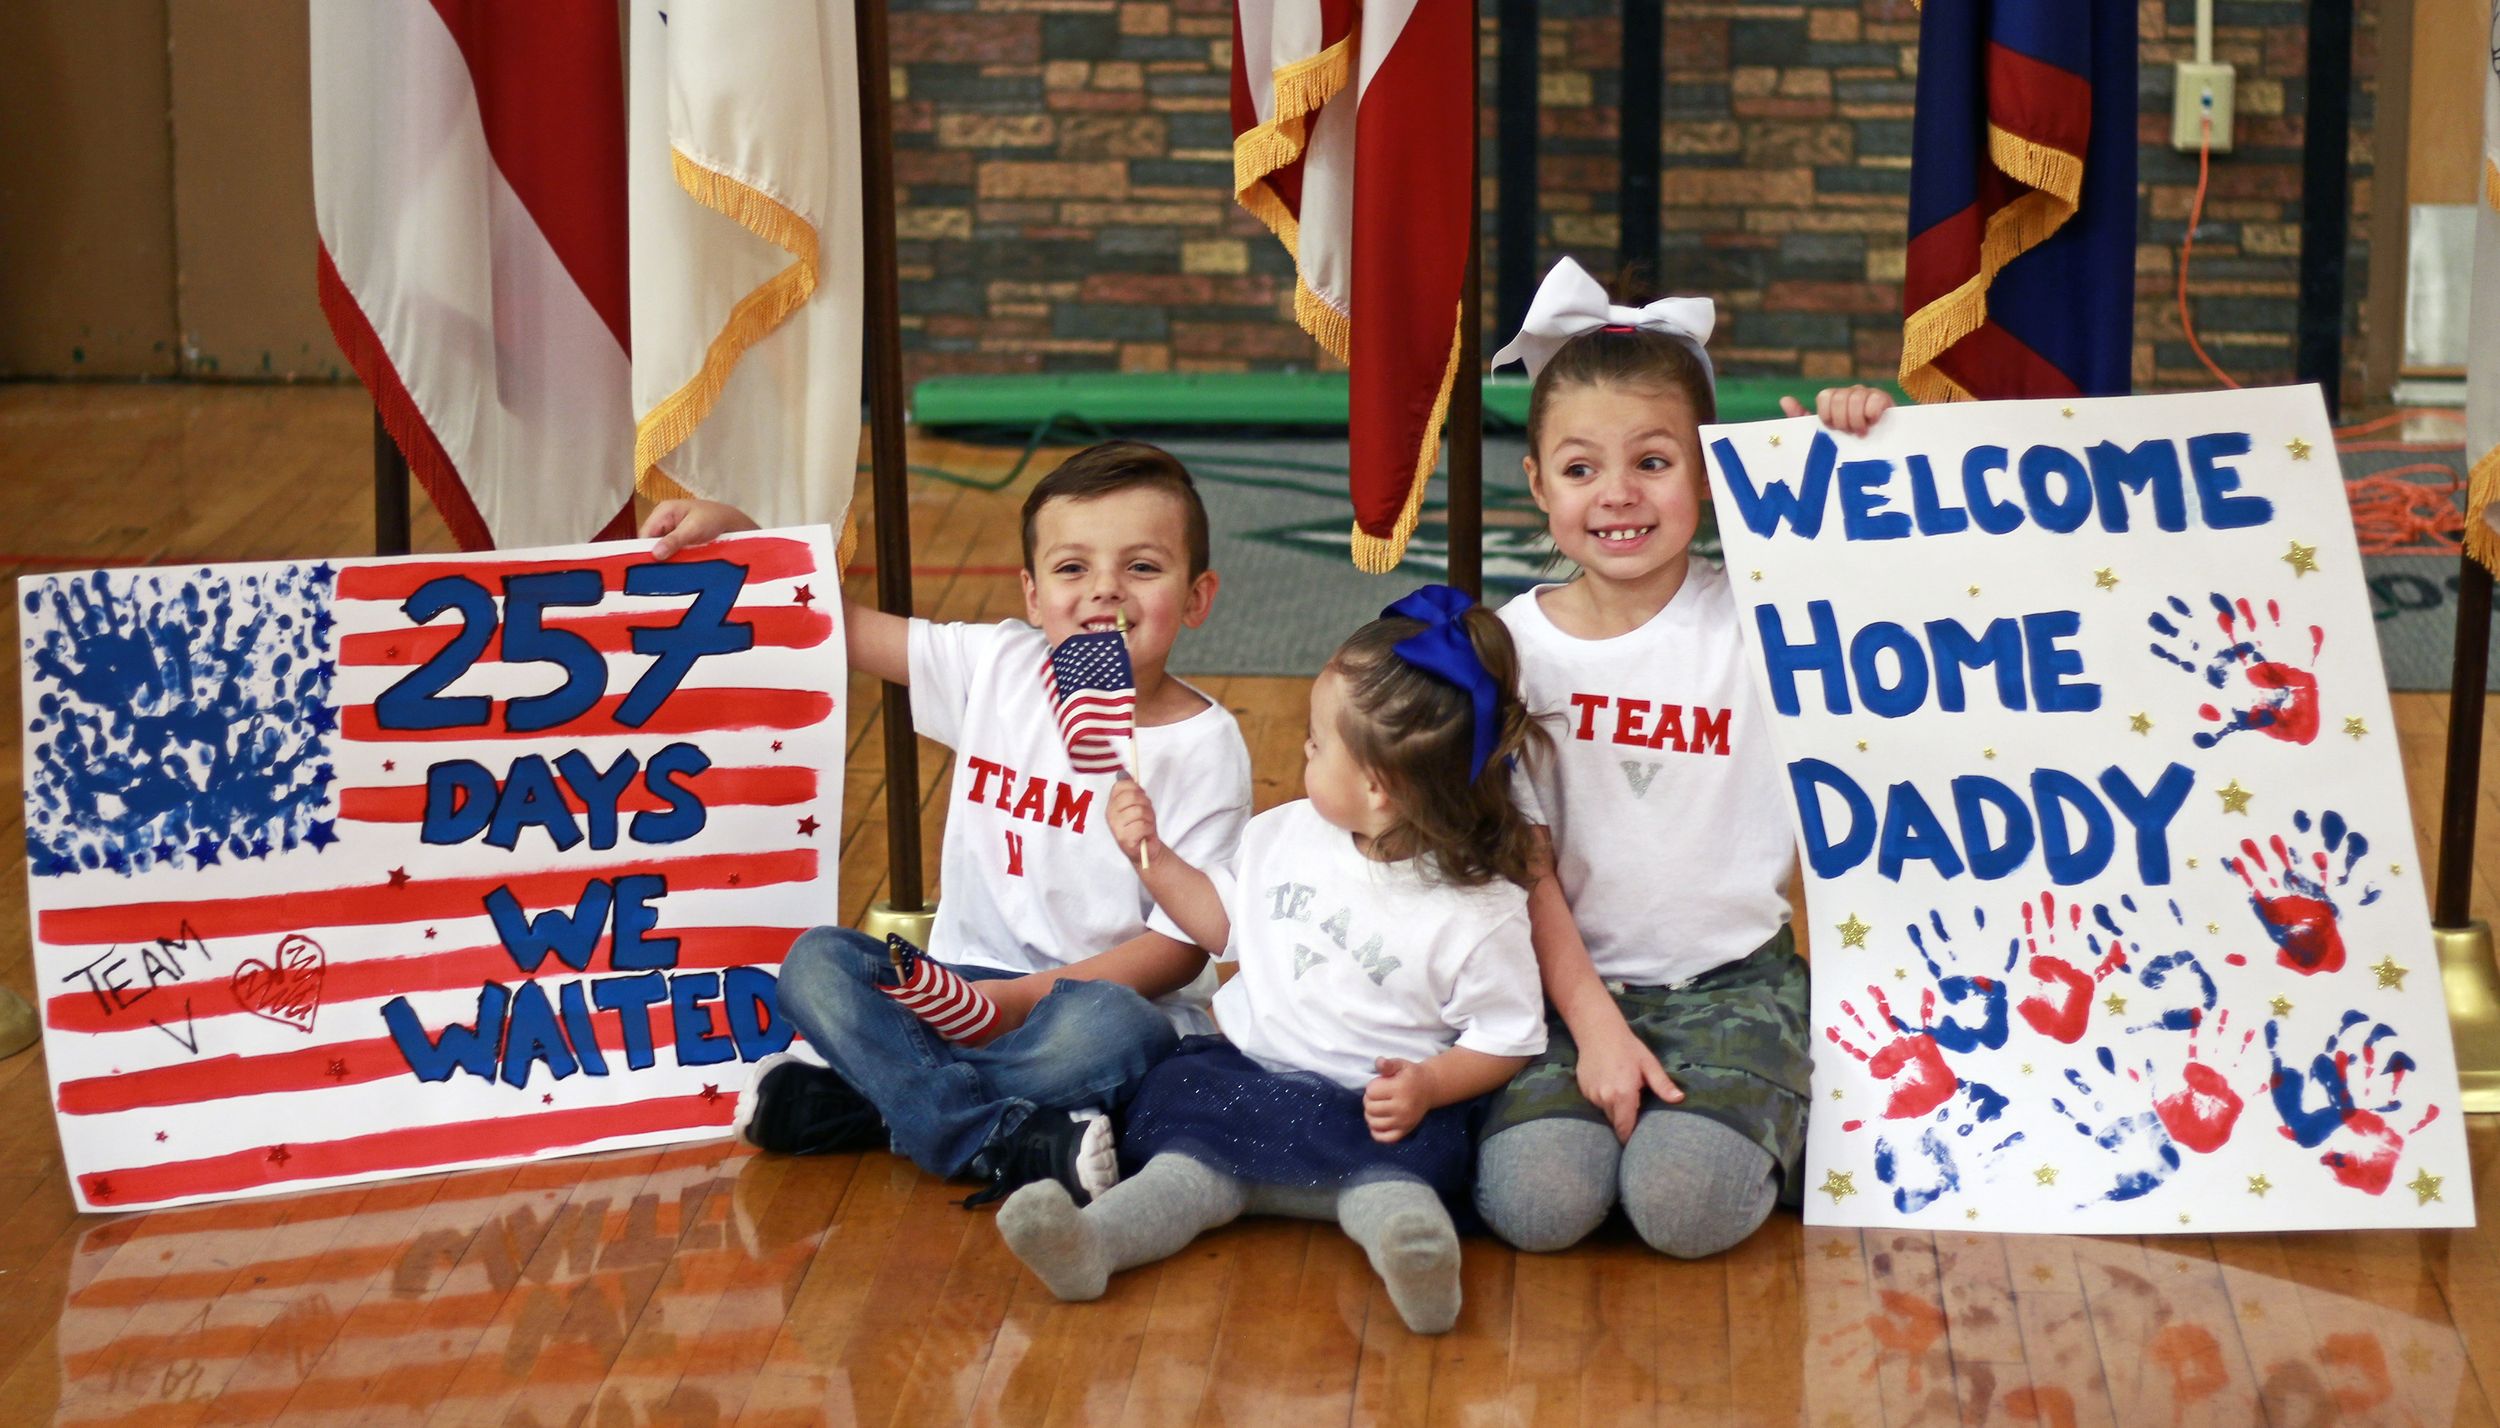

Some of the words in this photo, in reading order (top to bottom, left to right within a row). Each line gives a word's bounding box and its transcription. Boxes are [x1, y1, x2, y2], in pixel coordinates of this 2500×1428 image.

[1711, 429, 2273, 542] WELCOME
[374, 560, 754, 732] 257
[1754, 599, 2101, 719] HOME
[1570, 692, 1732, 756] TEAM
[421, 742, 711, 852] DAYS
[967, 756, 1093, 835] TEAM
[1619, 760, 1663, 800] V
[1788, 758, 2195, 886] DADDY
[1005, 830, 1024, 876] V
[63, 918, 212, 1017] TEAM
[483, 874, 681, 972] WE
[1266, 881, 1401, 987] TEAM
[1292, 942, 1328, 981] V
[151, 1018, 199, 1055] V
[380, 966, 796, 1089] WAITED
